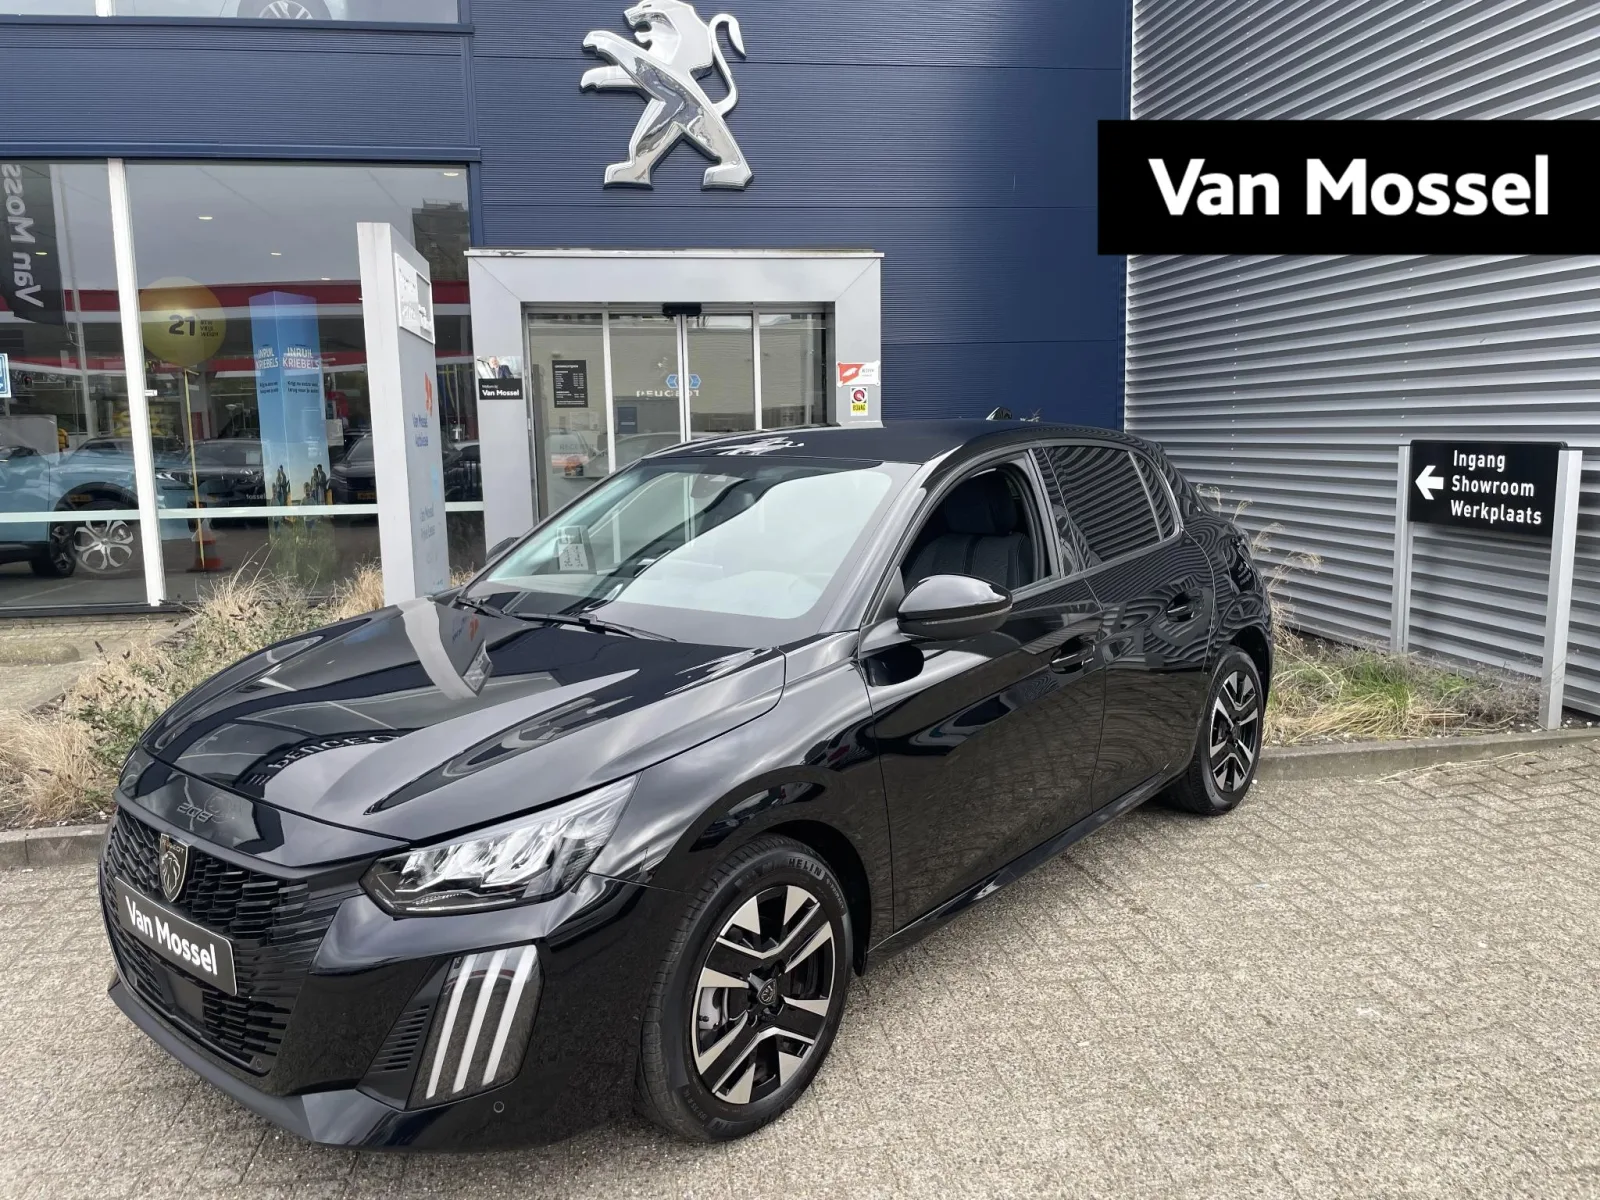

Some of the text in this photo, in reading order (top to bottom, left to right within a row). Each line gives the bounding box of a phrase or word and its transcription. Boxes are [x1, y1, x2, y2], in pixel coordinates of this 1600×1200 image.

[168, 314, 196, 337] 21
[283, 357, 320, 370] KRIEBELS
[1453, 449, 1506, 473] Ingang
[1451, 475, 1535, 497] Showroom
[1450, 500, 1542, 525] Werkplaats
[177, 802, 213, 823] 208
[125, 895, 218, 976] Van Mossel
